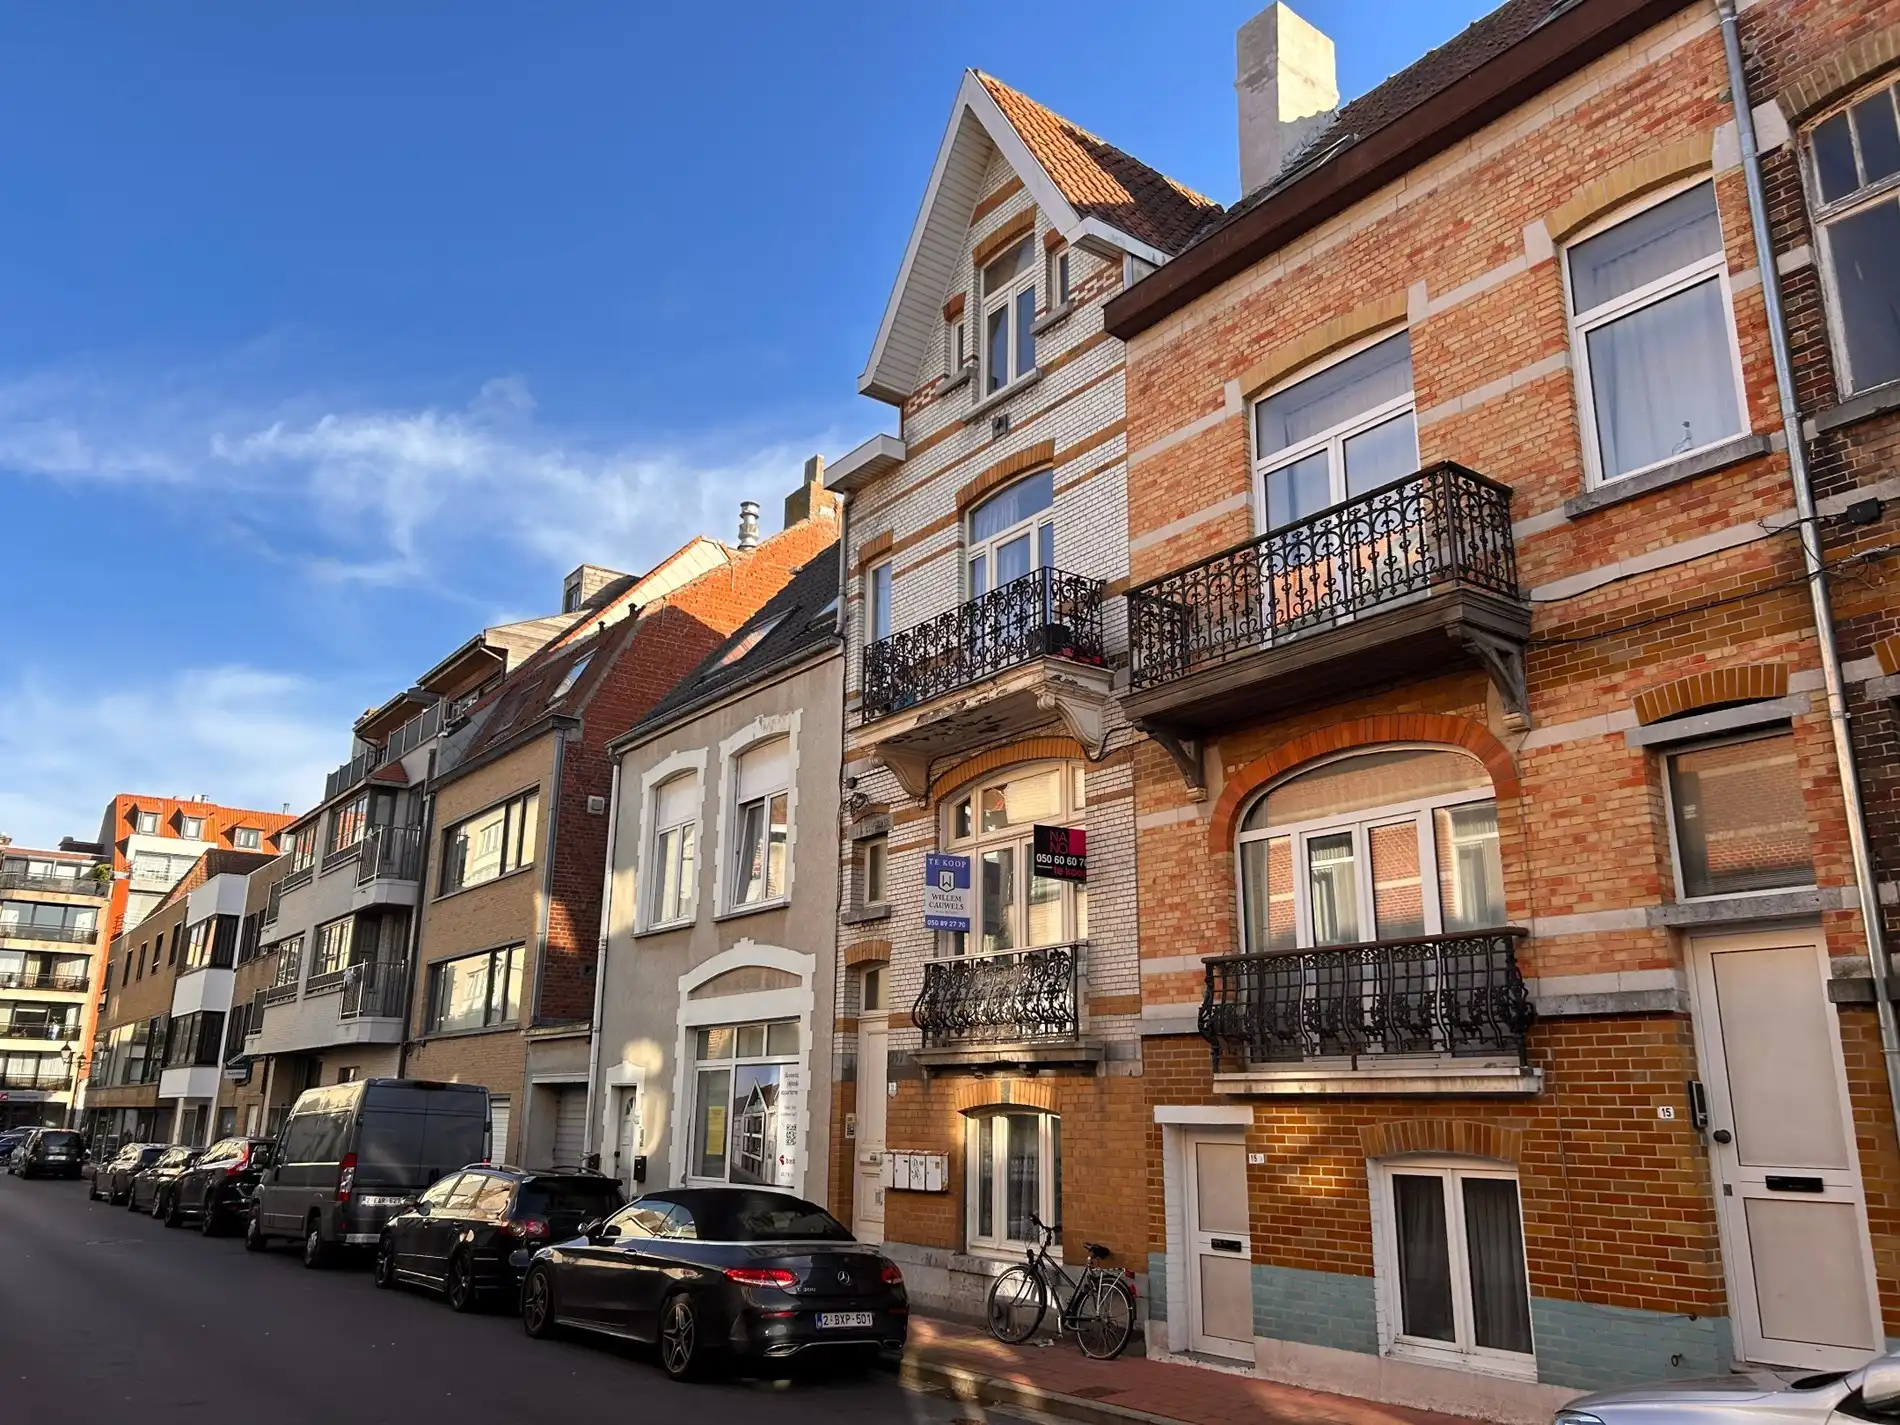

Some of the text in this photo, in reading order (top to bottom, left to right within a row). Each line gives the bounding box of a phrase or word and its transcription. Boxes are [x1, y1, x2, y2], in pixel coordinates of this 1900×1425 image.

[928, 858, 967, 868] TE KOOP
[1036, 854, 1052, 863] 050
[1054, 856, 1065, 865] 60
[1066, 857, 1077, 866] 60
[931, 893, 962, 903] WILLEM
[928, 902, 965, 910] CAUWELS
[1661, 1107, 1672, 1118] 15
[1250, 1154, 1258, 1163] 15
